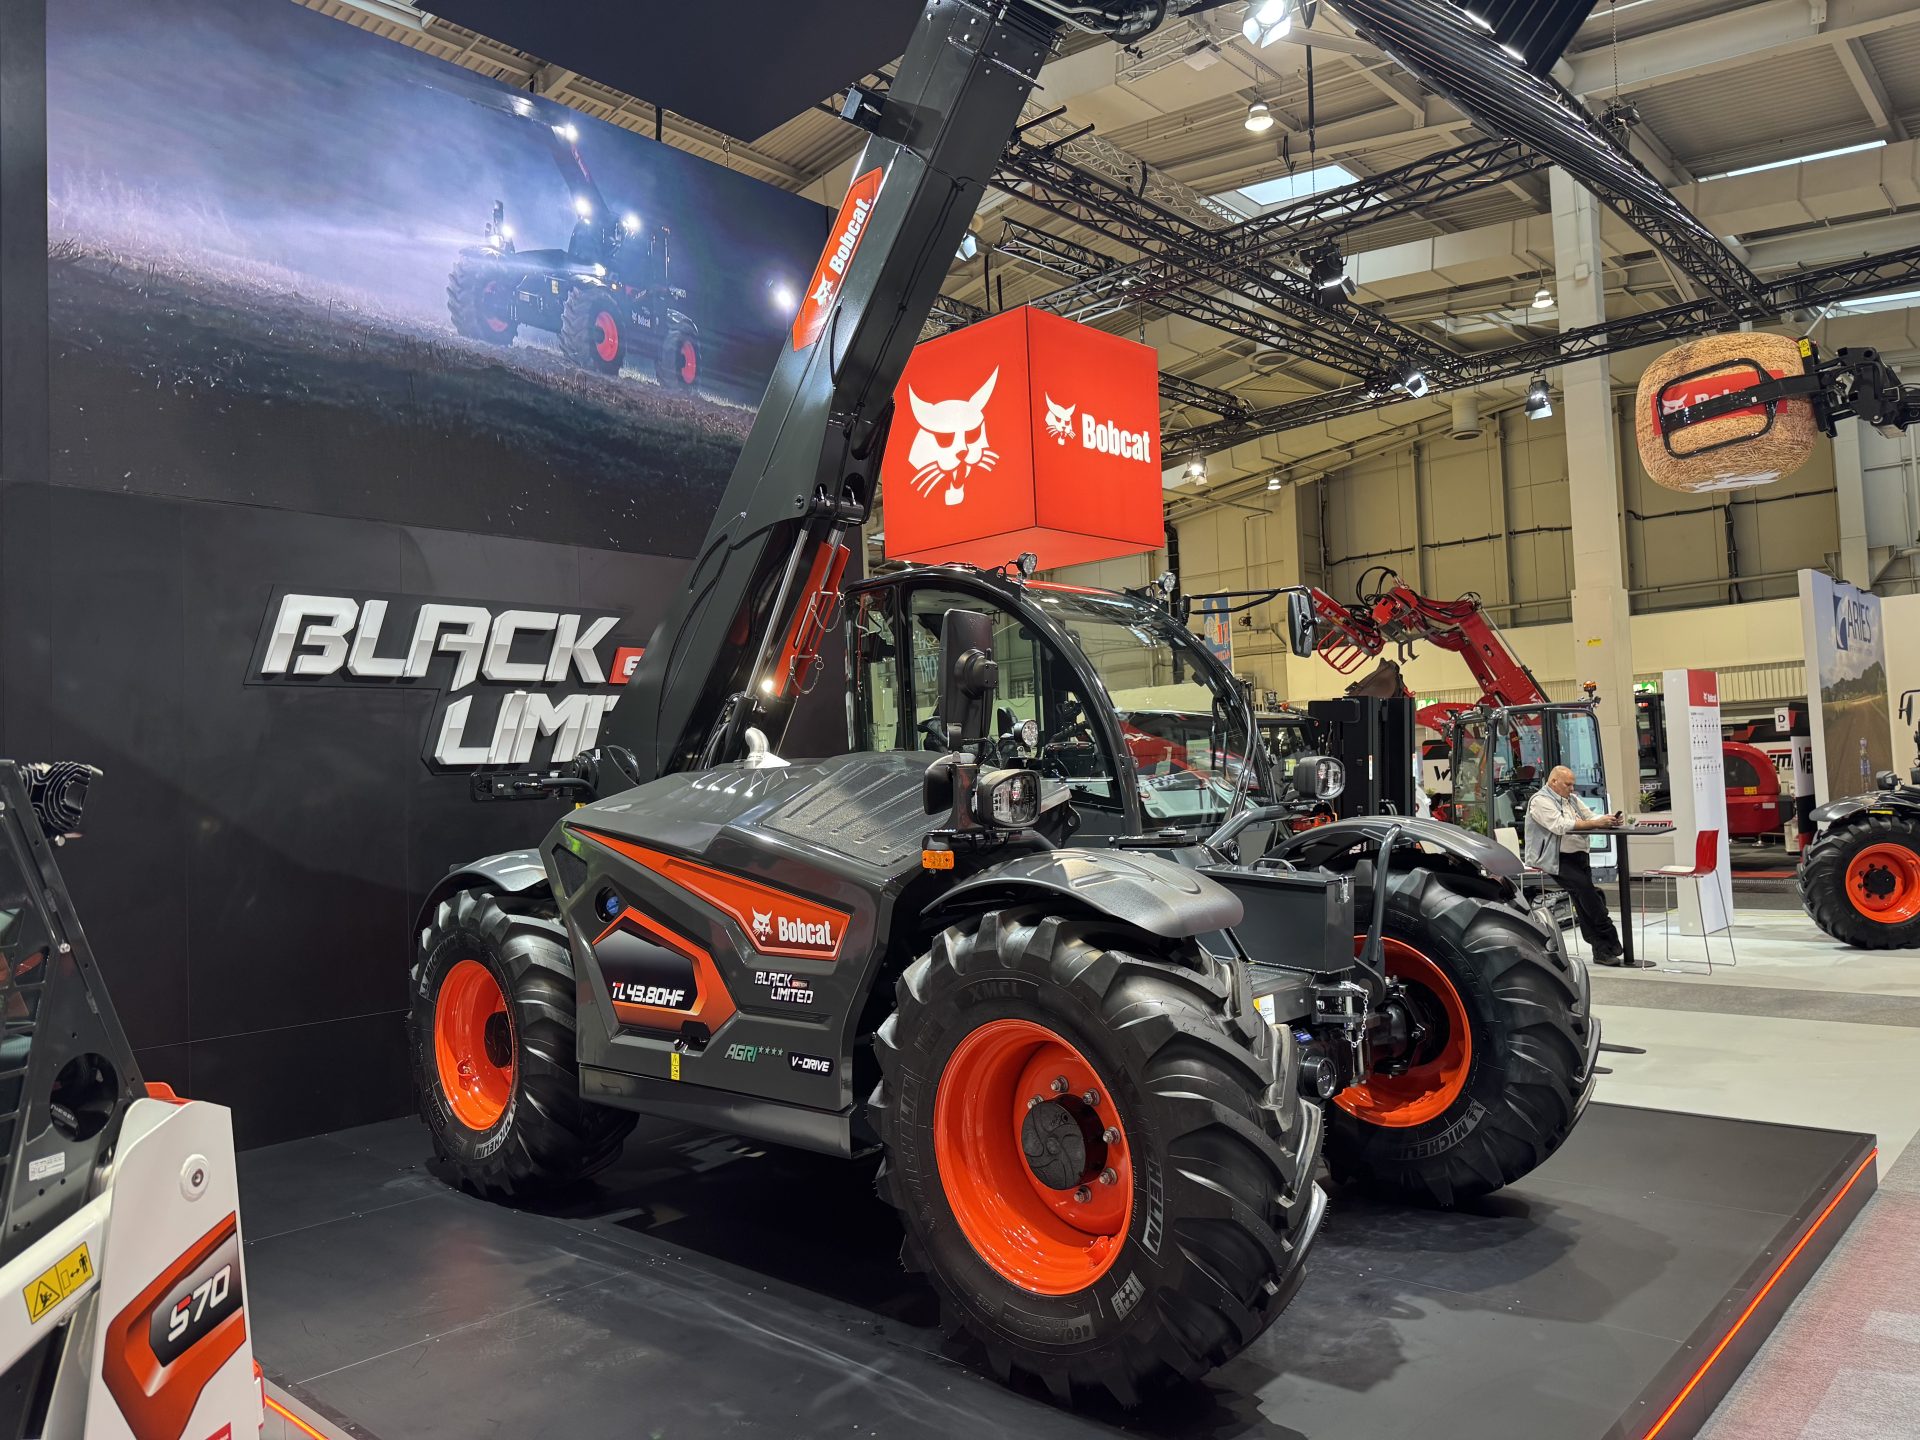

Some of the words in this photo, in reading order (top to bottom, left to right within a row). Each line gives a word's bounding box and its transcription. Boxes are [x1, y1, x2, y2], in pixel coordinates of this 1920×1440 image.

[829, 198, 873, 275] Bobcat
[1081, 413, 1151, 464] Bobcat
[261, 594, 621, 691] BLACK
[778, 916, 834, 946] Bobcat
[754, 971, 793, 987] BLACK
[612, 981, 685, 1006] TL43.80HF
[770, 988, 814, 1004] LIMITED
[724, 1043, 759, 1063] AGRI
[791, 1056, 830, 1073] V-DRIVE
[168, 1264, 231, 1342] S70
